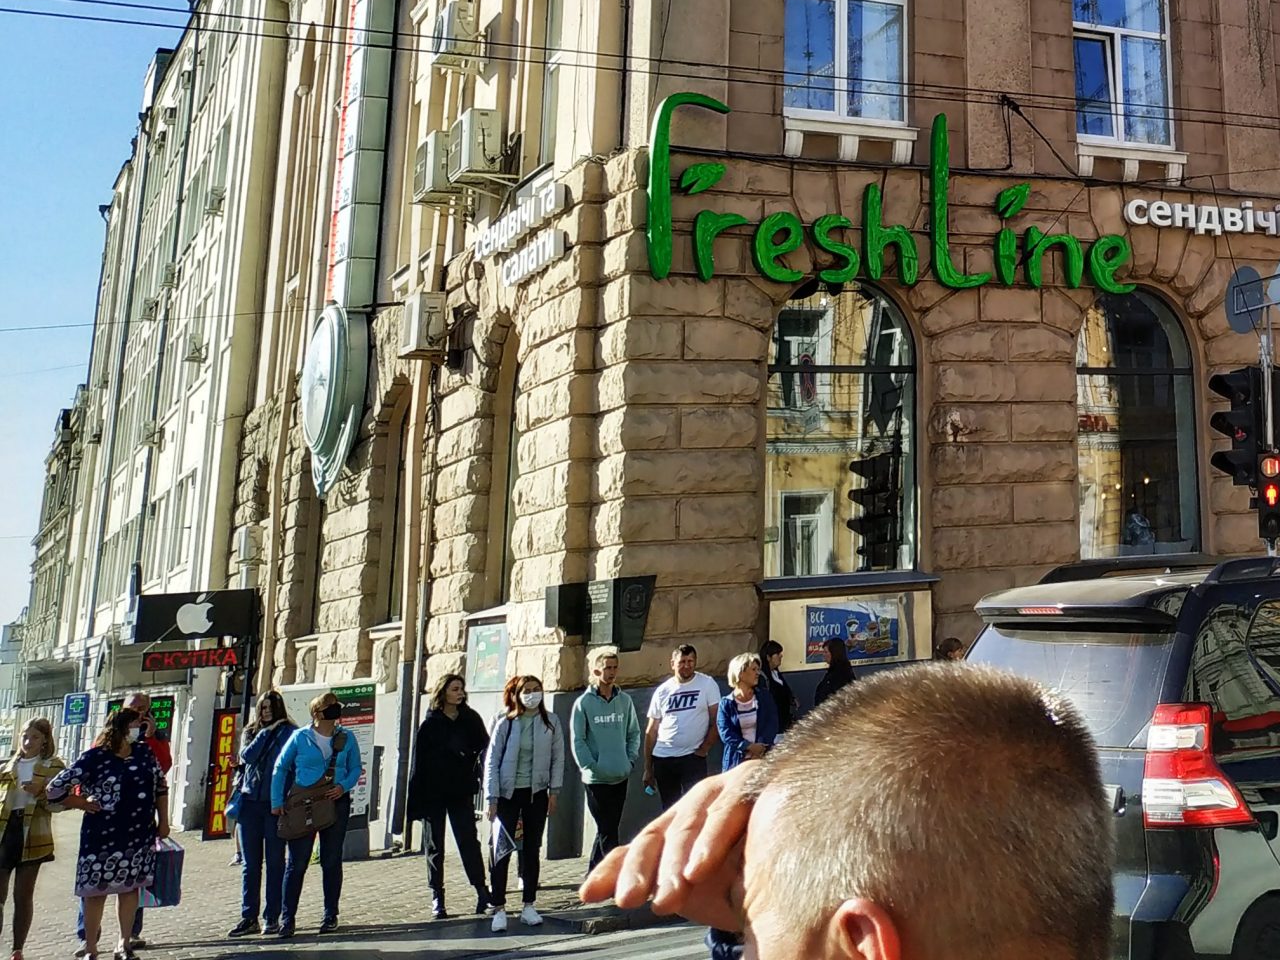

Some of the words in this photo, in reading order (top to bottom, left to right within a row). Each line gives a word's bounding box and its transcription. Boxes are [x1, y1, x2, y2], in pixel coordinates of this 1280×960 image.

[474, 195, 541, 262] сендвічі
[502, 228, 557, 287] салати
[809, 623, 841, 638] ПРОСТО
[810, 611, 825, 624] ВСЕ
[145, 648, 238, 671] СКУПКА
[211, 715, 233, 833] СКУПКА
